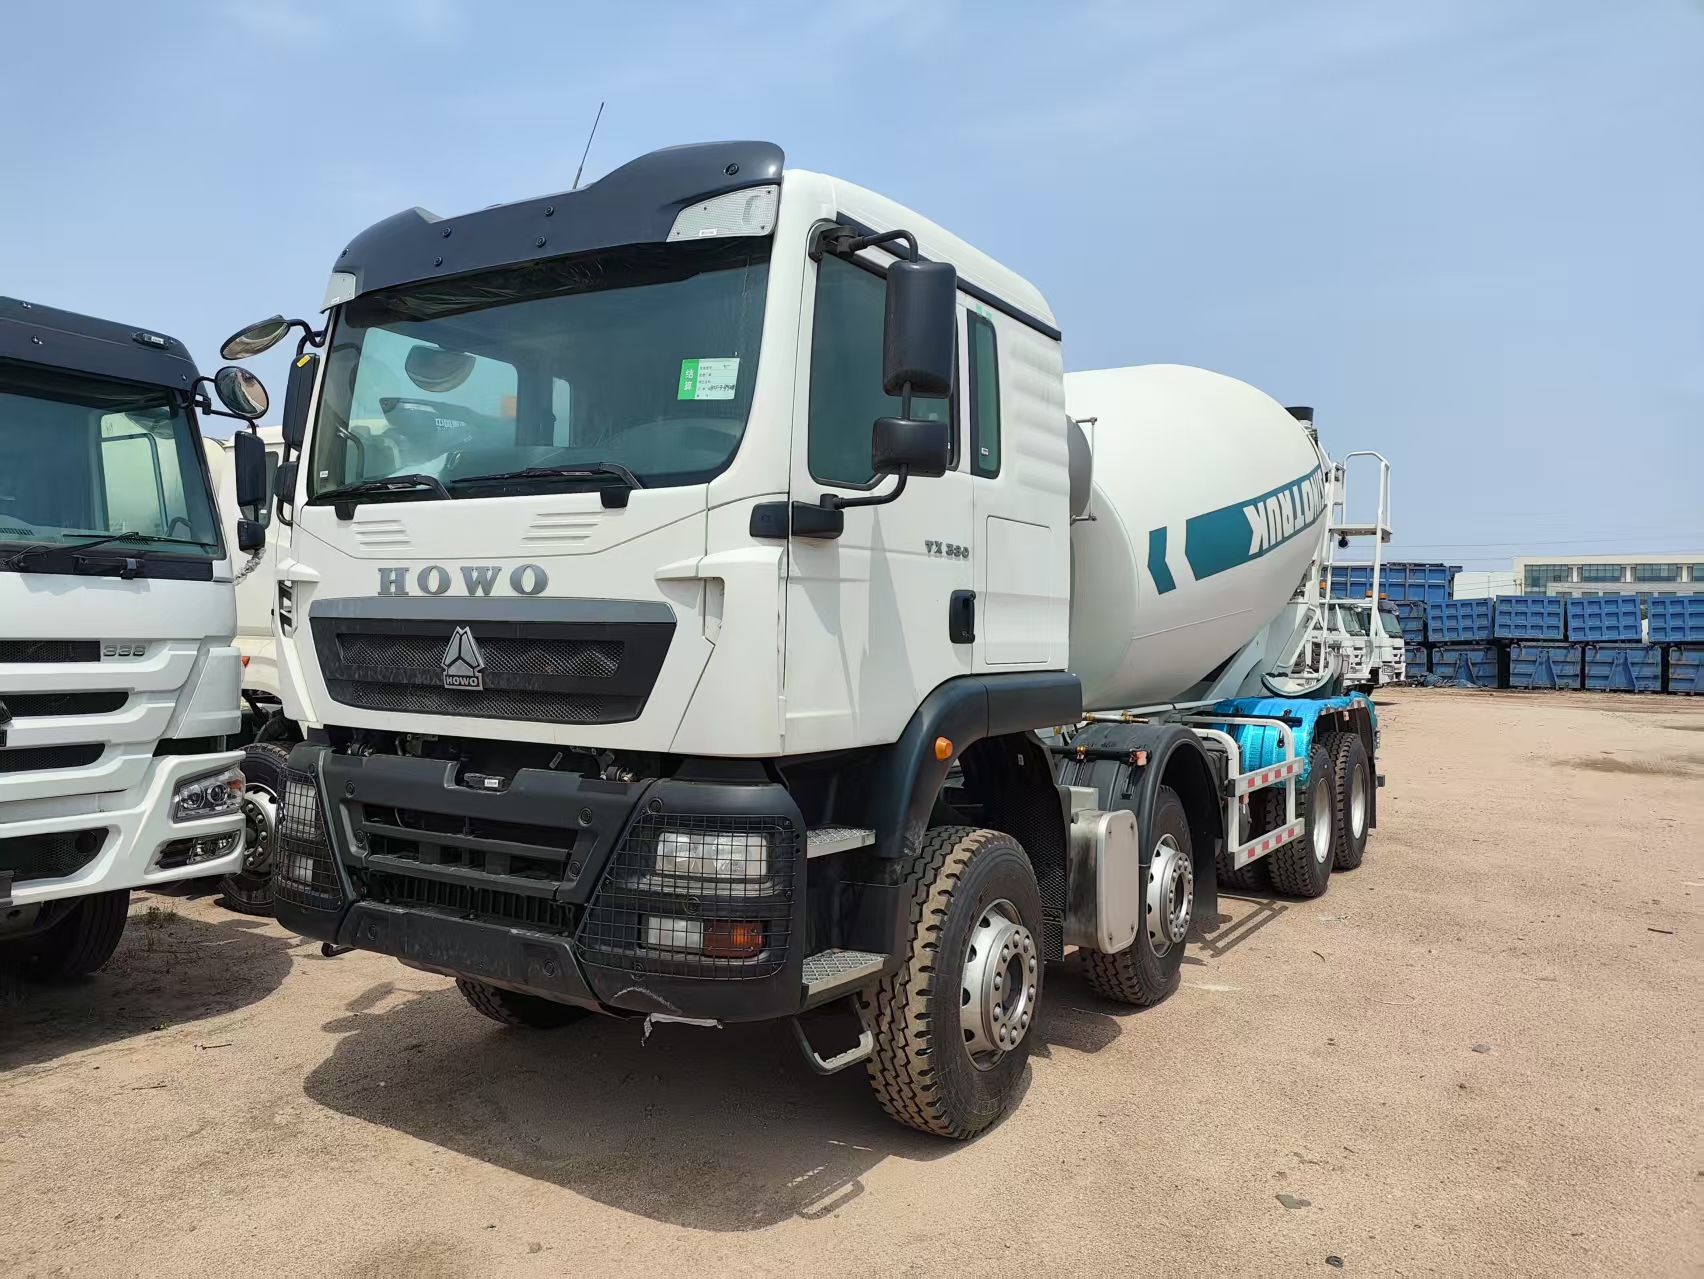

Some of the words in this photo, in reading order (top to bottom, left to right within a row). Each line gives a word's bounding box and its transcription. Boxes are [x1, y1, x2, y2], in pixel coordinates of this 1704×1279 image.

[684, 368, 694, 392] 结算
[924, 539, 943, 555] TX
[377, 563, 550, 596] HOWO
[446, 676, 478, 686] HOWO
